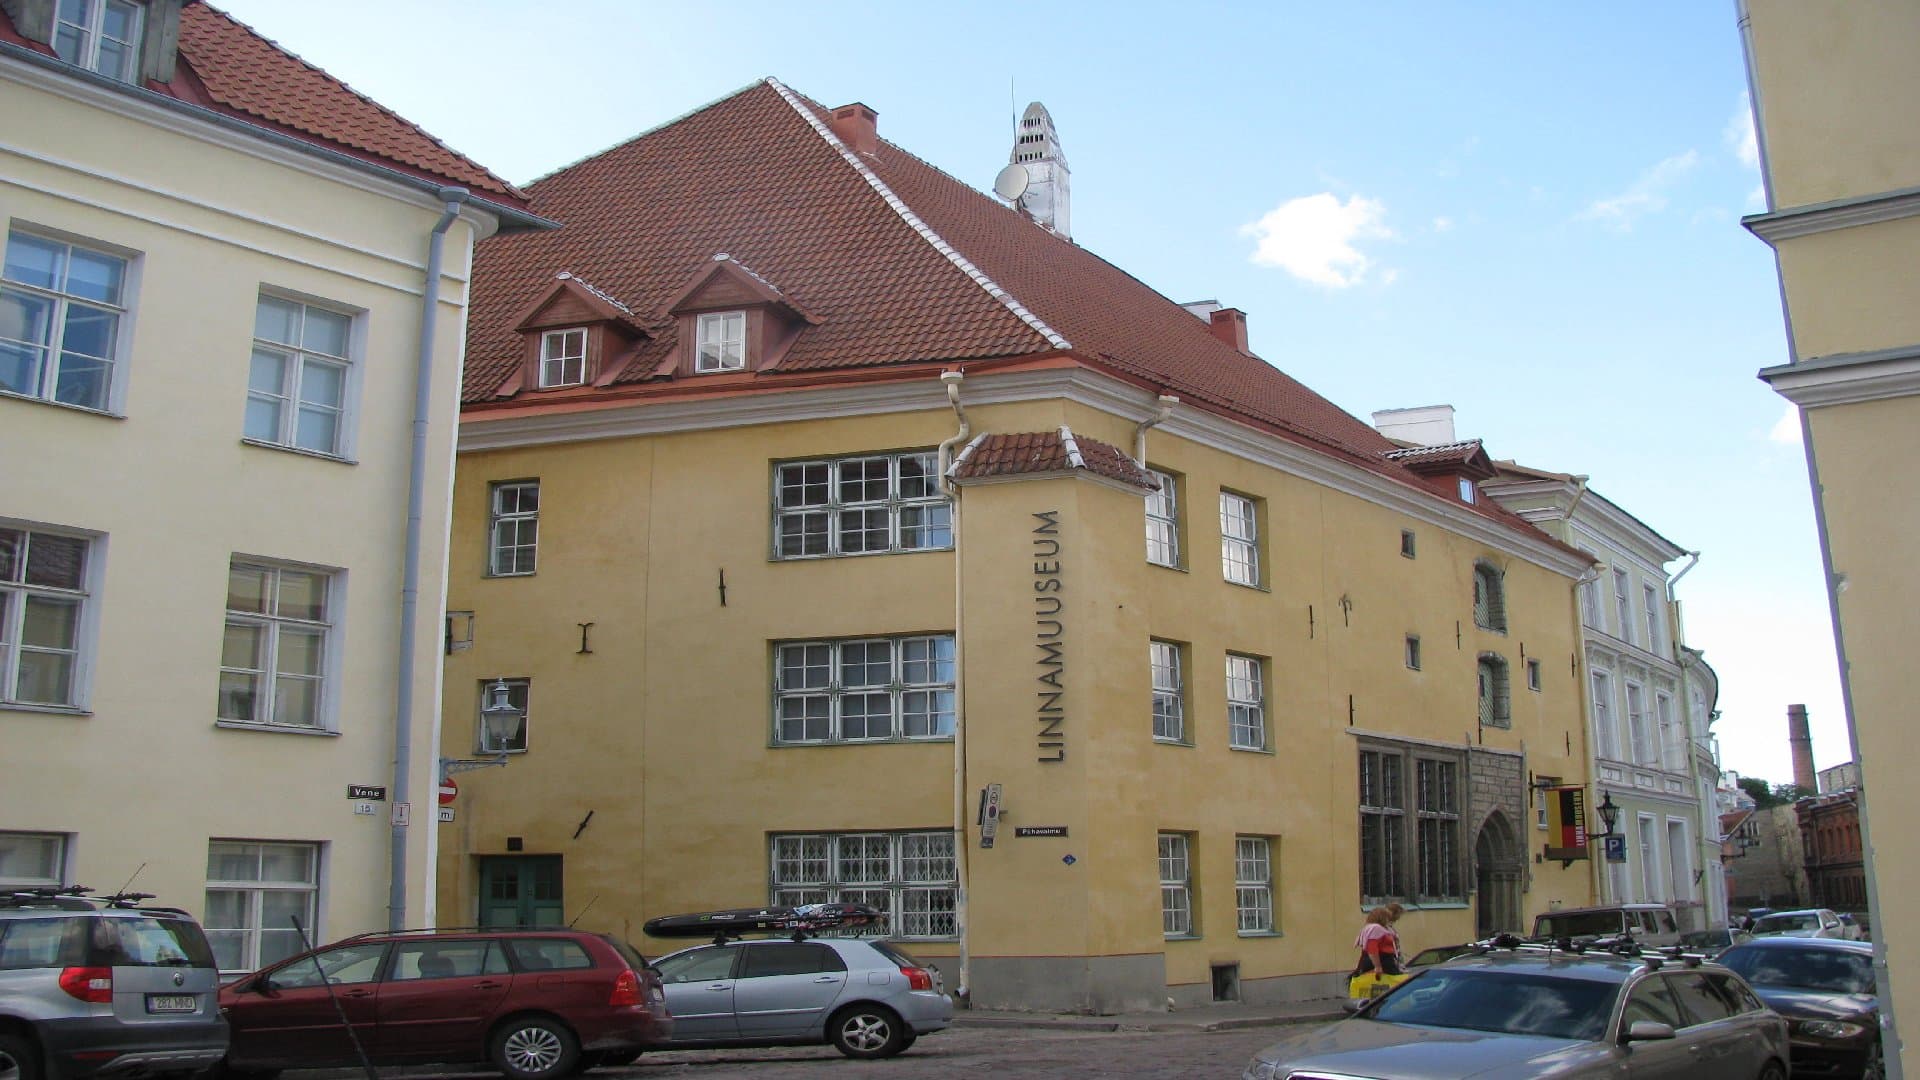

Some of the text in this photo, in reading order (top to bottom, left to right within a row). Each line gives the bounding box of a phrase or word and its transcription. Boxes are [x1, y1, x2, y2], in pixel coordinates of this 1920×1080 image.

[1032, 510, 1064, 763] LINNAMUUSEUM
[355, 787, 380, 797] Vene
[1609, 839, 1620, 851] P
